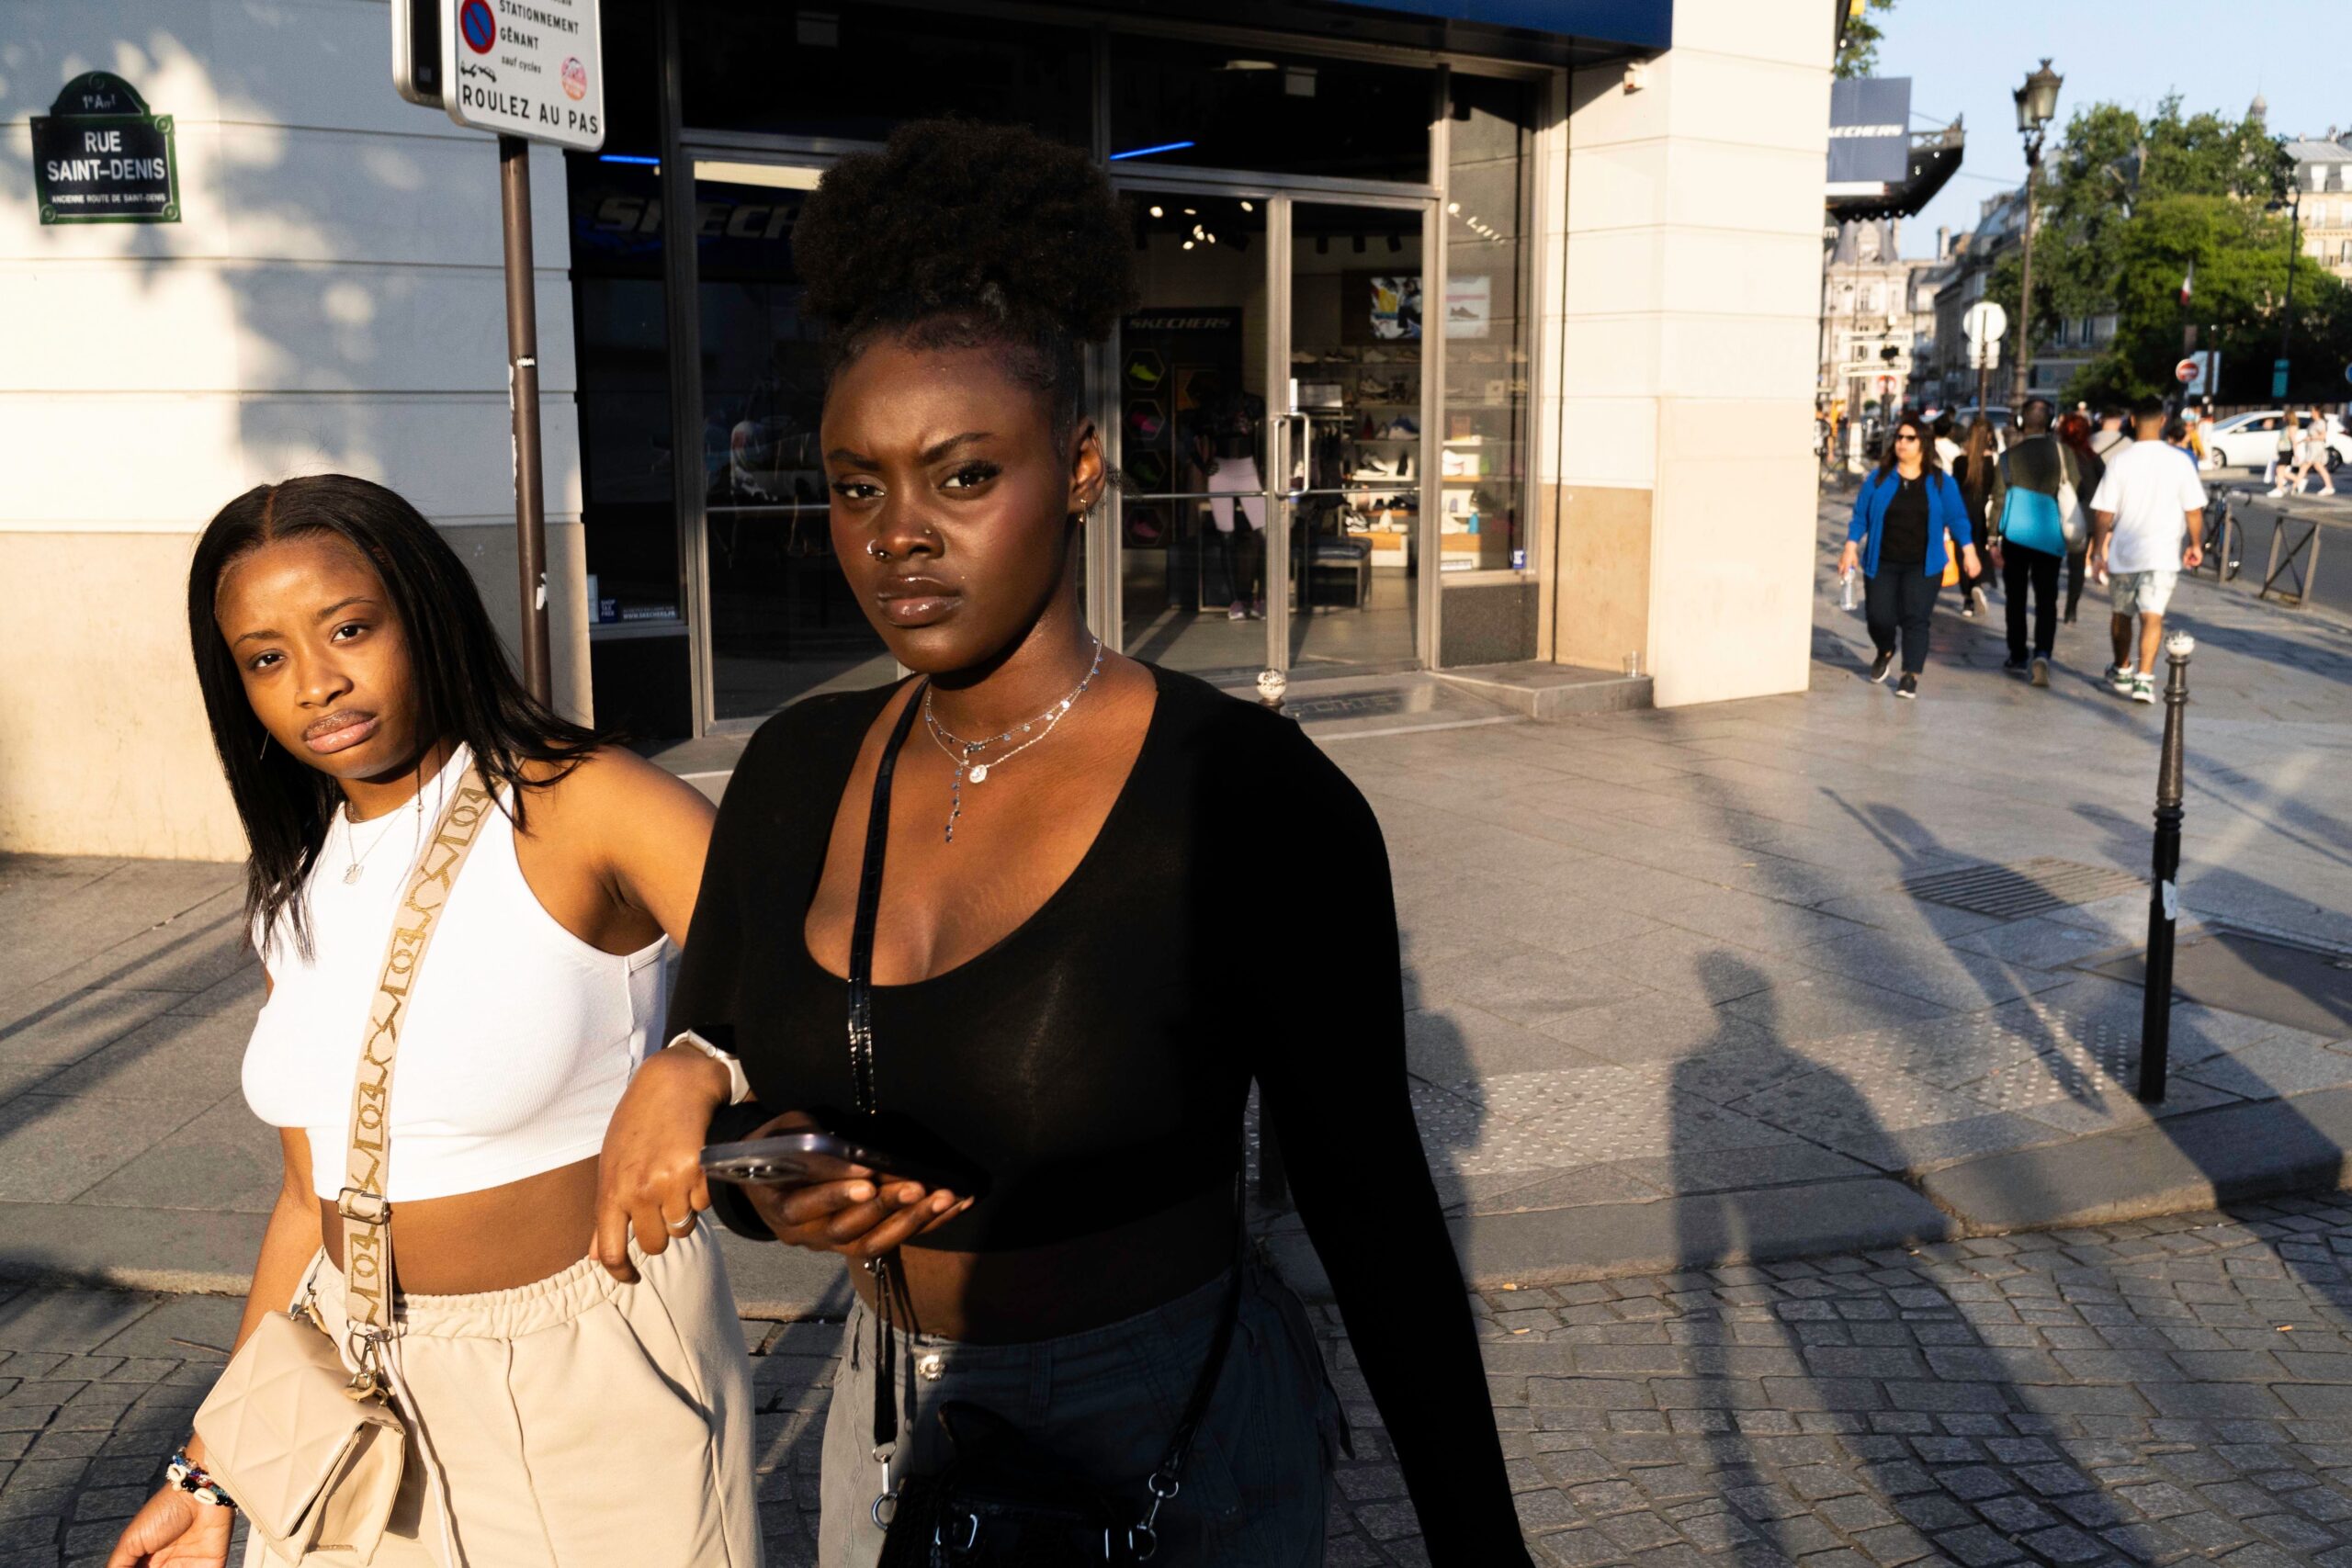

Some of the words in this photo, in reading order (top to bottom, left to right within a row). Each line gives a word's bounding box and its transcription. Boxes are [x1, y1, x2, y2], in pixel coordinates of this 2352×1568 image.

[499, 0, 579, 34] STATIONNEMENT
[500, 26, 538, 50] GÊNANT
[502, 55, 517, 66] sauf
[519, 61, 541, 73] cycles
[462, 85, 530, 119] ROULEZ
[539, 103, 560, 126] AU
[569, 110, 597, 134] PAS
[85, 131, 122, 152] RUE
[47, 158, 165, 182] SAINT-DENIS
[52, 194, 85, 204] ANCIENNE
[86, 194, 109, 203] ROUTE
[111, 193, 121, 202] DE
[123, 193, 166, 202] SAINT-DENIS
[1128, 317, 1232, 330] SKECHERS
